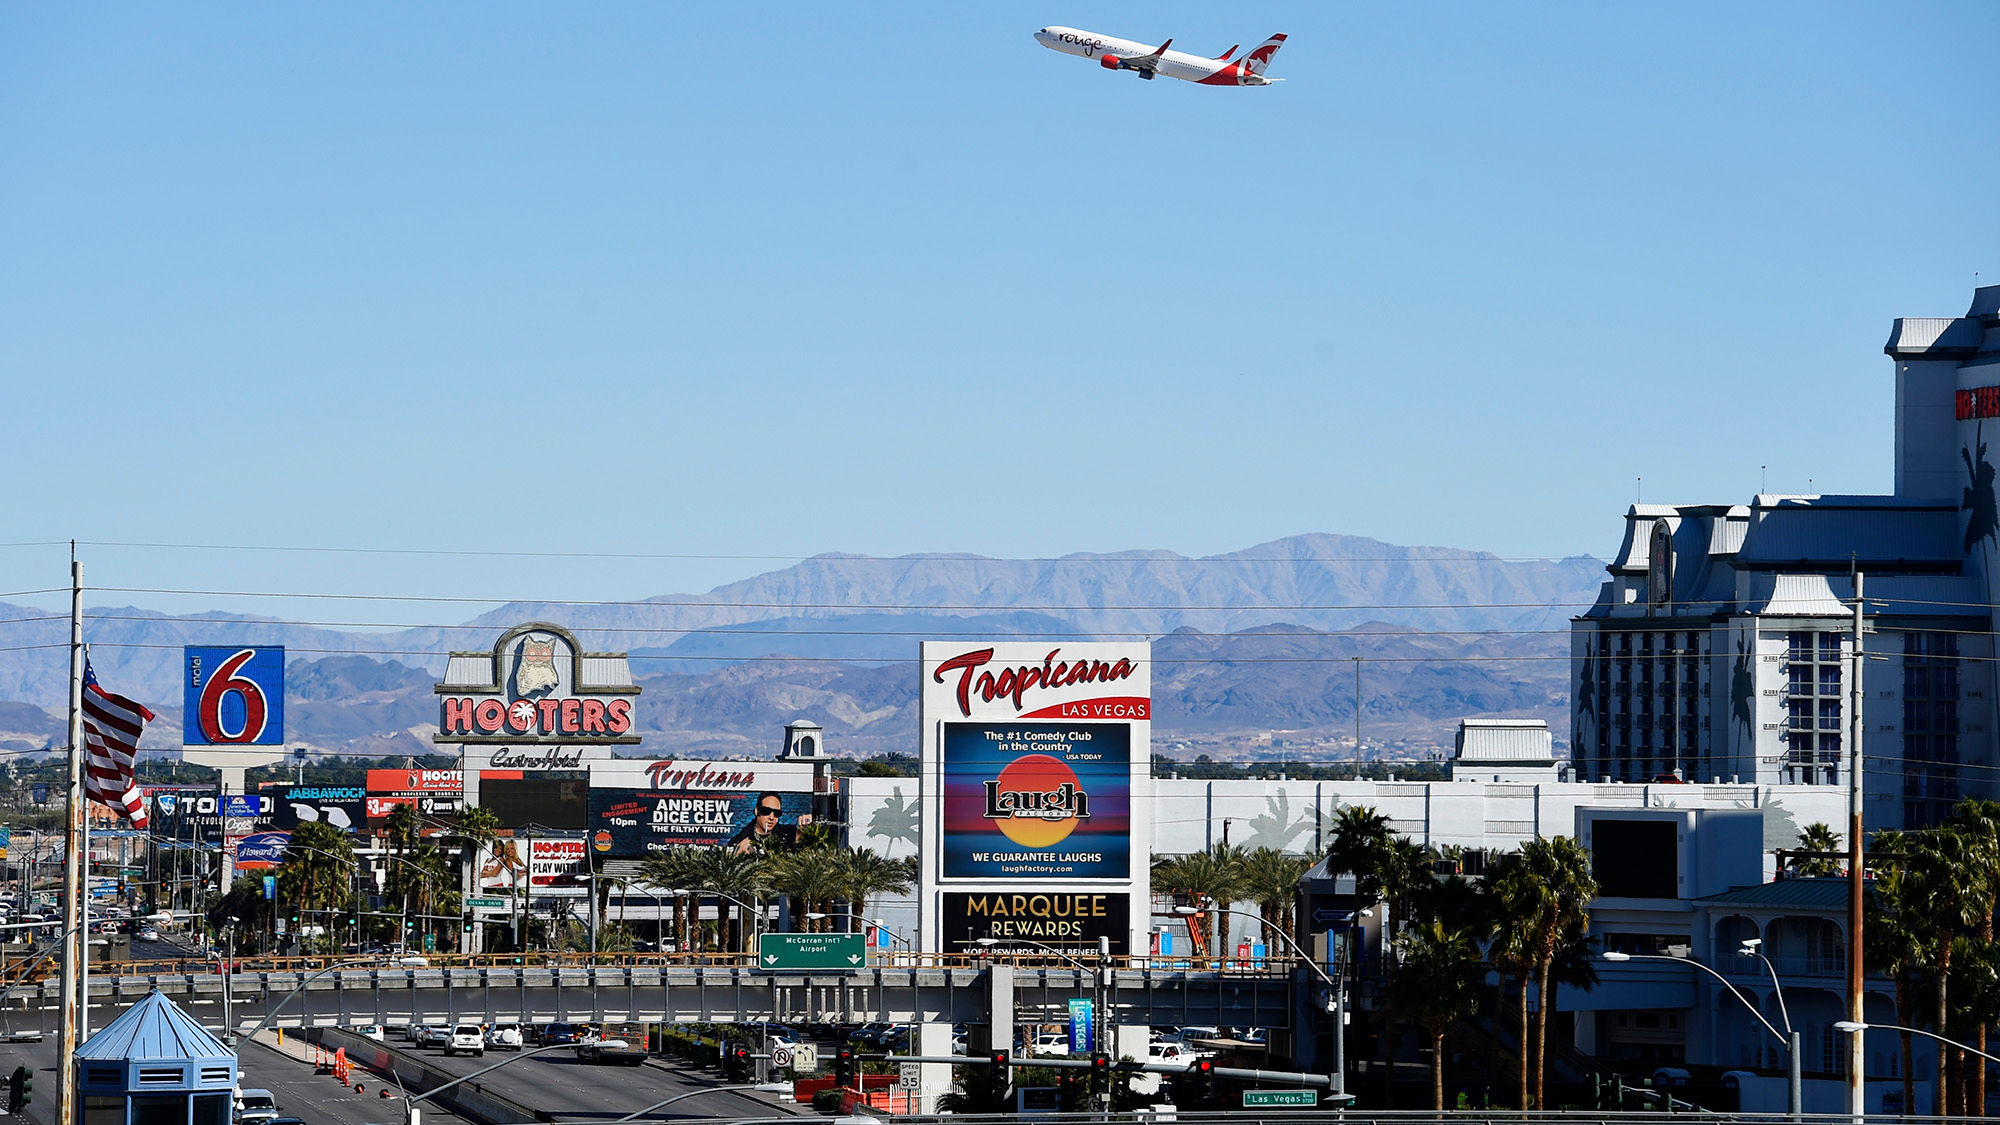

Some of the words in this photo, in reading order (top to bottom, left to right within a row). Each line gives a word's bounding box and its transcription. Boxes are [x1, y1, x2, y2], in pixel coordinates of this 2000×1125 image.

[1059, 33, 1102, 57] rouge
[192, 655, 201, 686] motel
[934, 647, 1139, 717] Tropicana
[198, 648, 268, 742] 6
[446, 697, 631, 733] HOOTERS
[1062, 704, 1091, 716] LAS
[1094, 704, 1146, 717] VEGAS
[984, 731, 1004, 741] The
[1007, 731, 1021, 741] #1
[1024, 731, 1066, 743] Comedy
[1068, 731, 1092, 741] Club
[998, 742, 1008, 751] in
[1011, 742, 1029, 751] the
[1031, 742, 1073, 753] Country
[422, 770, 463, 781] HOOTE
[644, 760, 755, 789] Tropicana
[285, 787, 366, 799] JABBAWOCK
[422, 798, 434, 815] $2
[434, 802, 452, 811] SHOTS
[610, 802, 638, 811] LIMITED
[656, 799, 731, 812] ANDREW
[983, 780, 1091, 820] Laugh
[602, 806, 648, 818] ENGAGEMENT
[653, 811, 690, 824] DICE
[693, 812, 734, 824] CLAY
[610, 817, 637, 827] 10pm
[652, 825, 669, 833] THE
[670, 826, 701, 834] FILTHY
[702, 826, 731, 834] TRUTH
[972, 853, 990, 862] WE
[992, 853, 1056, 862] GUARANTEE
[1059, 853, 1102, 863] LAUGHS
[533, 863, 552, 873] PLAY
[554, 863, 577, 873] WITH
[1001, 865, 1073, 873] laughfactory.com
[967, 895, 1107, 918] MARQUEE
[991, 920, 1082, 936] REWARDS
[1075, 1006, 1086, 1022] LAS
[1075, 1023, 1086, 1050] VEGAS
[902, 1077, 918, 1087] 35
[1252, 1095, 1268, 1103] Las
[1273, 1095, 1300, 1104] Vegas
